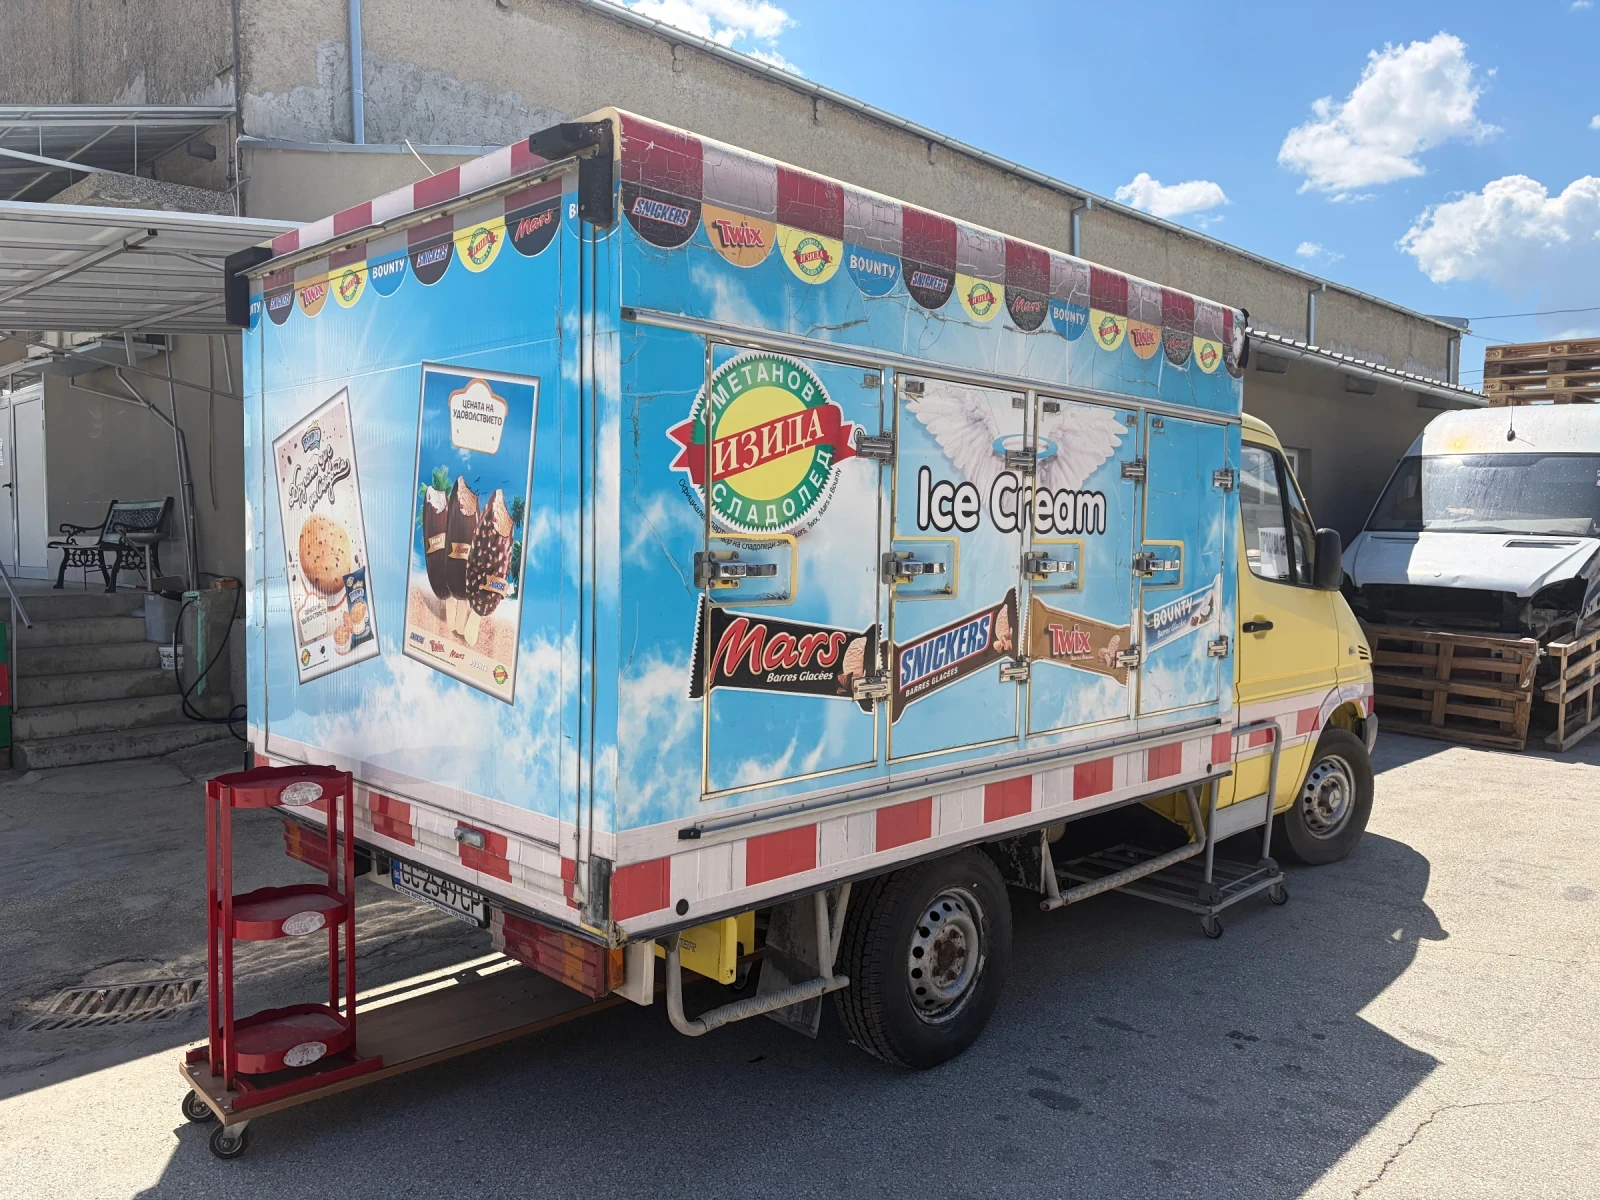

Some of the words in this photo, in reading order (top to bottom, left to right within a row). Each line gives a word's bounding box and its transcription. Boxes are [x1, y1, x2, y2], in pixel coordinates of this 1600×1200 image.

[634, 198, 689, 226] SNICKERS
[515, 209, 553, 242] Mars
[713, 219, 764, 248] Twix
[372, 258, 405, 279] BOUNTY
[800, 250, 824, 263] ИЗИДА
[850, 254, 896, 278] BOUNTY
[912, 272, 947, 292] SNICKERS
[300, 283, 324, 307] Twix
[1011, 296, 1042, 313] Mars
[1053, 307, 1085, 325] BOUNTY
[1131, 328, 1155, 346] Twix
[1167, 336, 1188, 350] Mars
[462, 399, 485, 411] ЦЕНАТА
[485, 403, 494, 412] НА
[700, 363, 814, 426] СМЕТАНОВ
[453, 409, 503, 426] УДОВОЛСТВИЕТО
[713, 408, 825, 476] ИЗИДА
[712, 450, 833, 527] СЛАДОЛЕД
[917, 465, 981, 533] Ice
[989, 471, 1106, 535] Cream
[679, 479, 706, 521] Официале
[733, 540, 741, 548] на
[818, 500, 830, 517] Mars
[830, 468, 843, 494] Bounty
[1153, 597, 1193, 629] BOUNTY
[709, 618, 846, 685] Mars
[900, 615, 991, 688] SNICKERS
[1048, 623, 1092, 656] Twix
[449, 649, 465, 659] Mars
[766, 673, 797, 683] Barres
[799, 670, 834, 681] Glacées
[905, 680, 930, 697] BARRES
